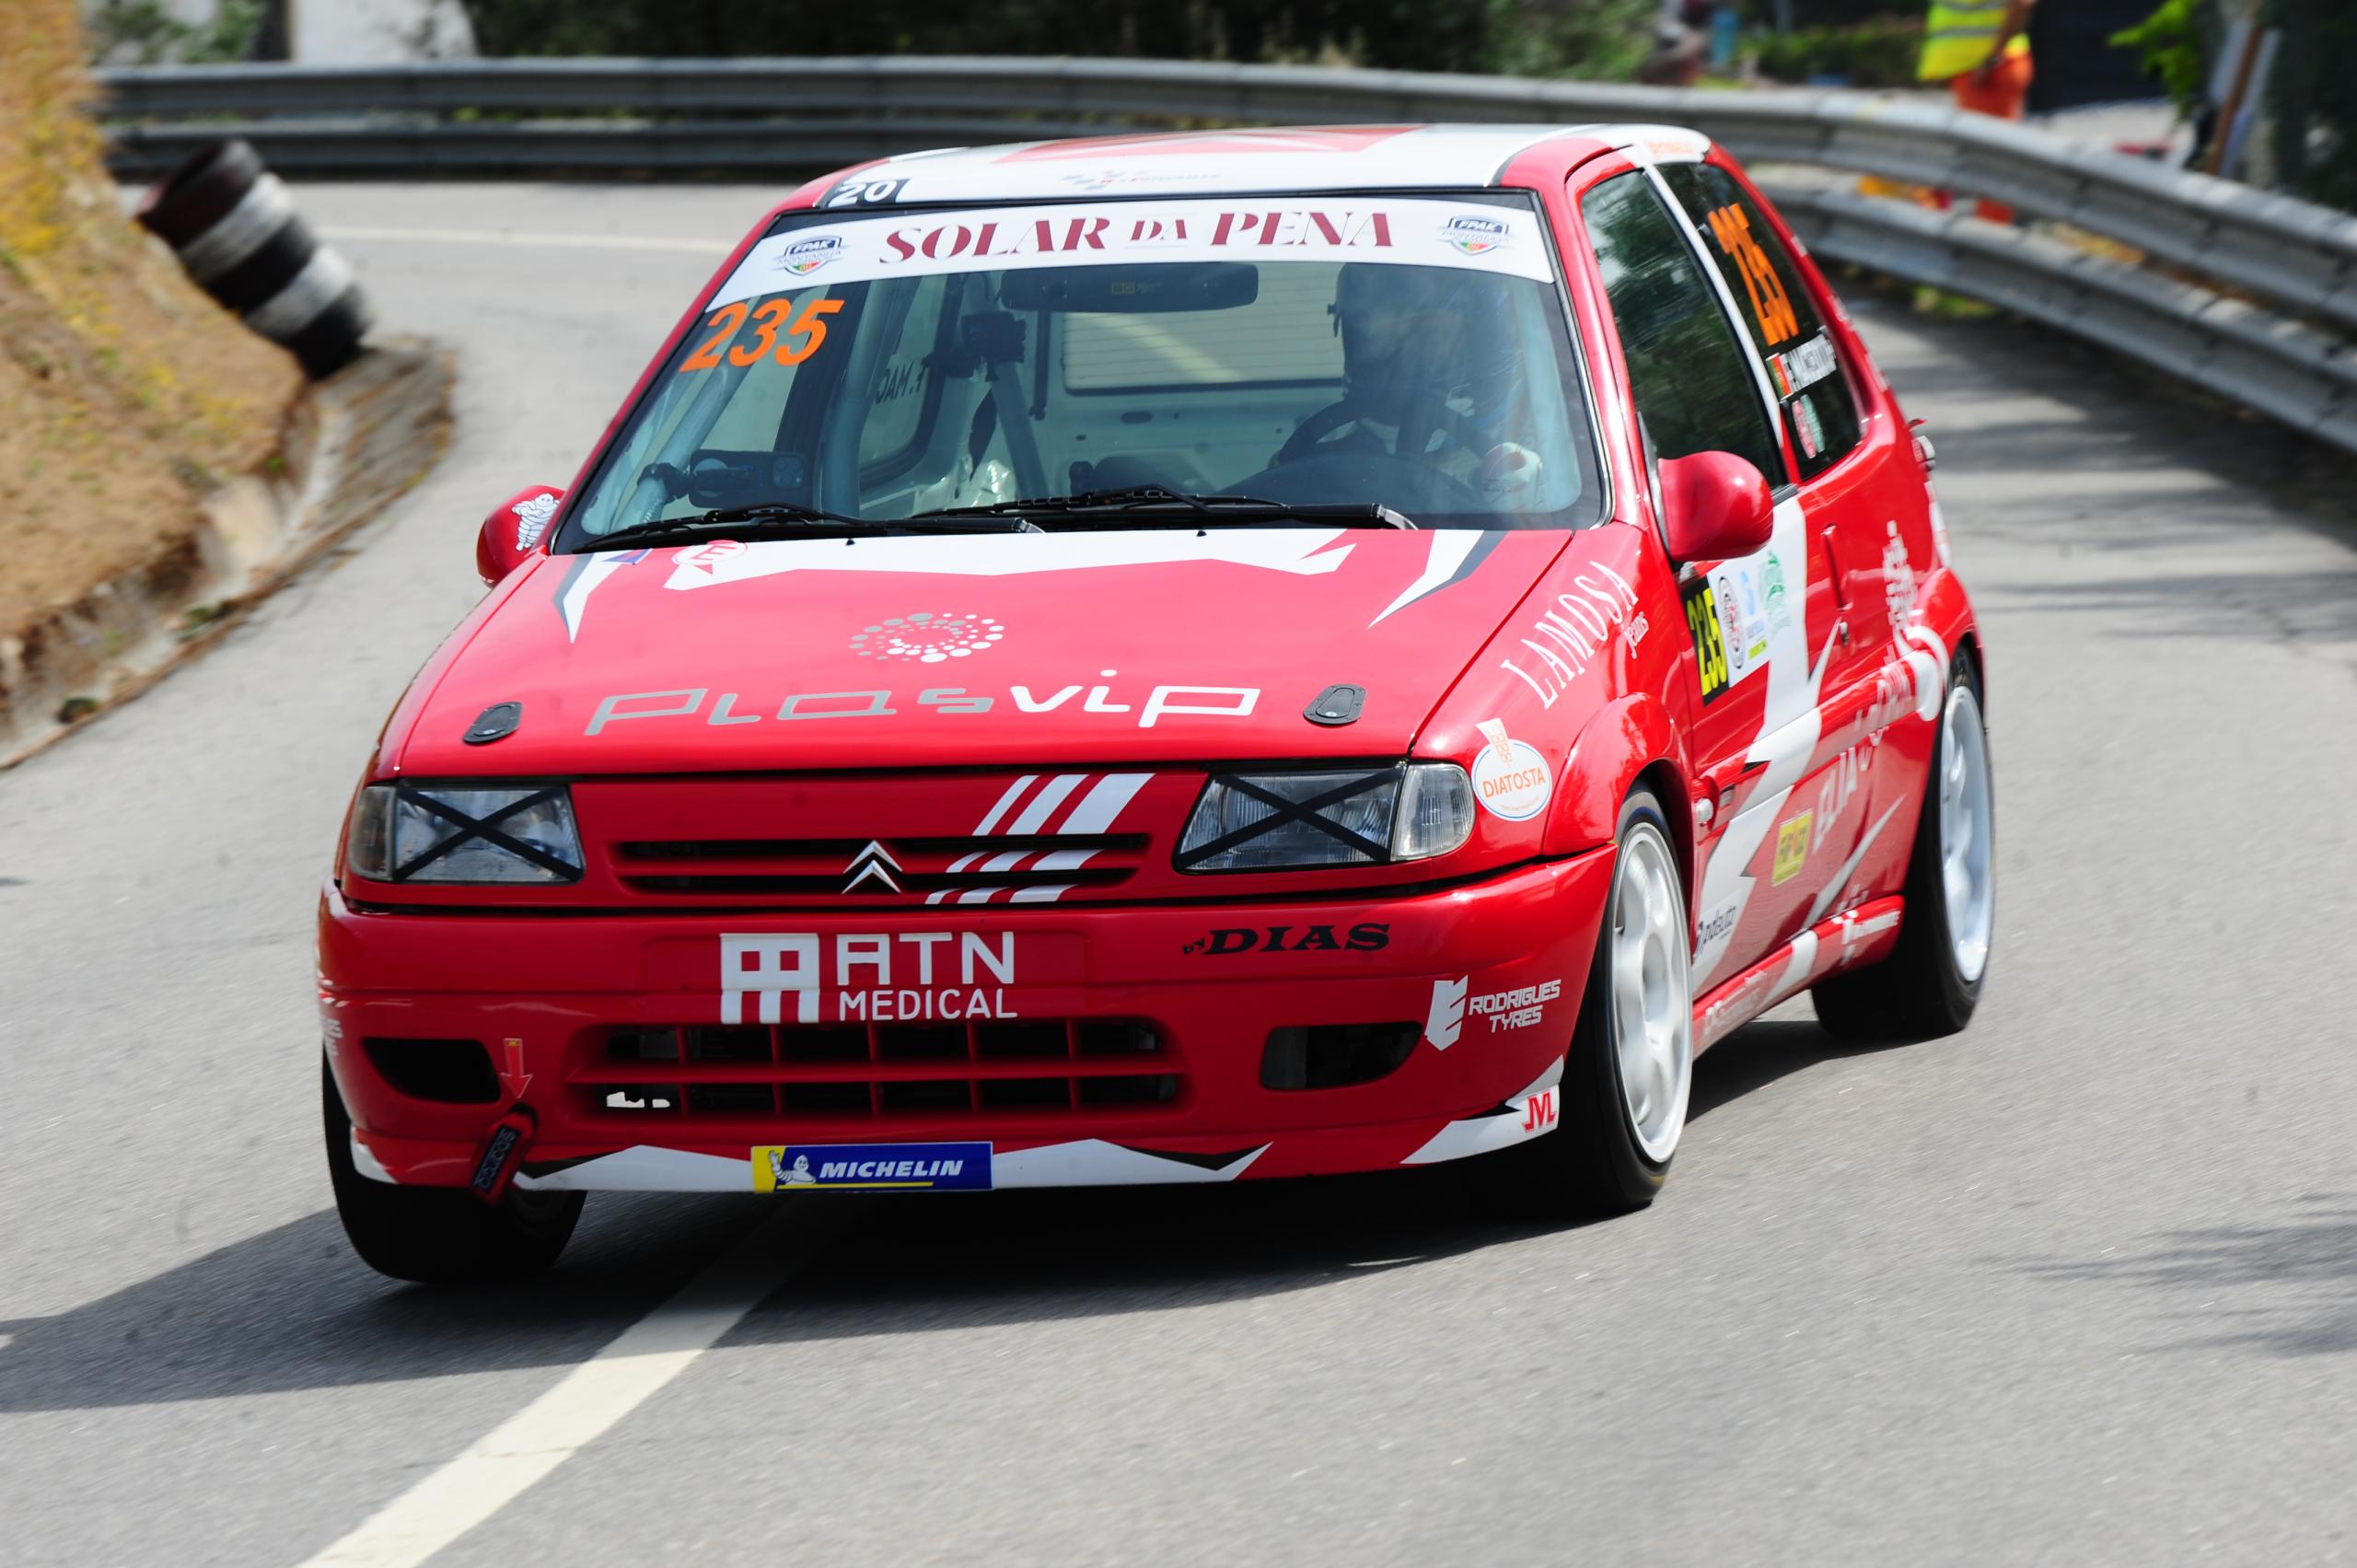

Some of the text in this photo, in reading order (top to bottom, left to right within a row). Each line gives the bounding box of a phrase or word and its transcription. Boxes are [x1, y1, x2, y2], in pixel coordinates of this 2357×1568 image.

[878, 212, 1393, 264] SOLAR DA PENA
[679, 298, 845, 373] 235
[1500, 560, 1640, 710] LAMOSA
[1687, 587, 1728, 696] 235
[1481, 767, 1546, 798] DIATOSTA
[1201, 923, 1391, 955] DIAS
[836, 931, 1016, 986] ATN
[839, 987, 1017, 1021] MEDICAL
[1469, 979, 1562, 1016] RODRIGUES
[1489, 1005, 1544, 1033] TYRES
[819, 1159, 964, 1179] MICHELIN
